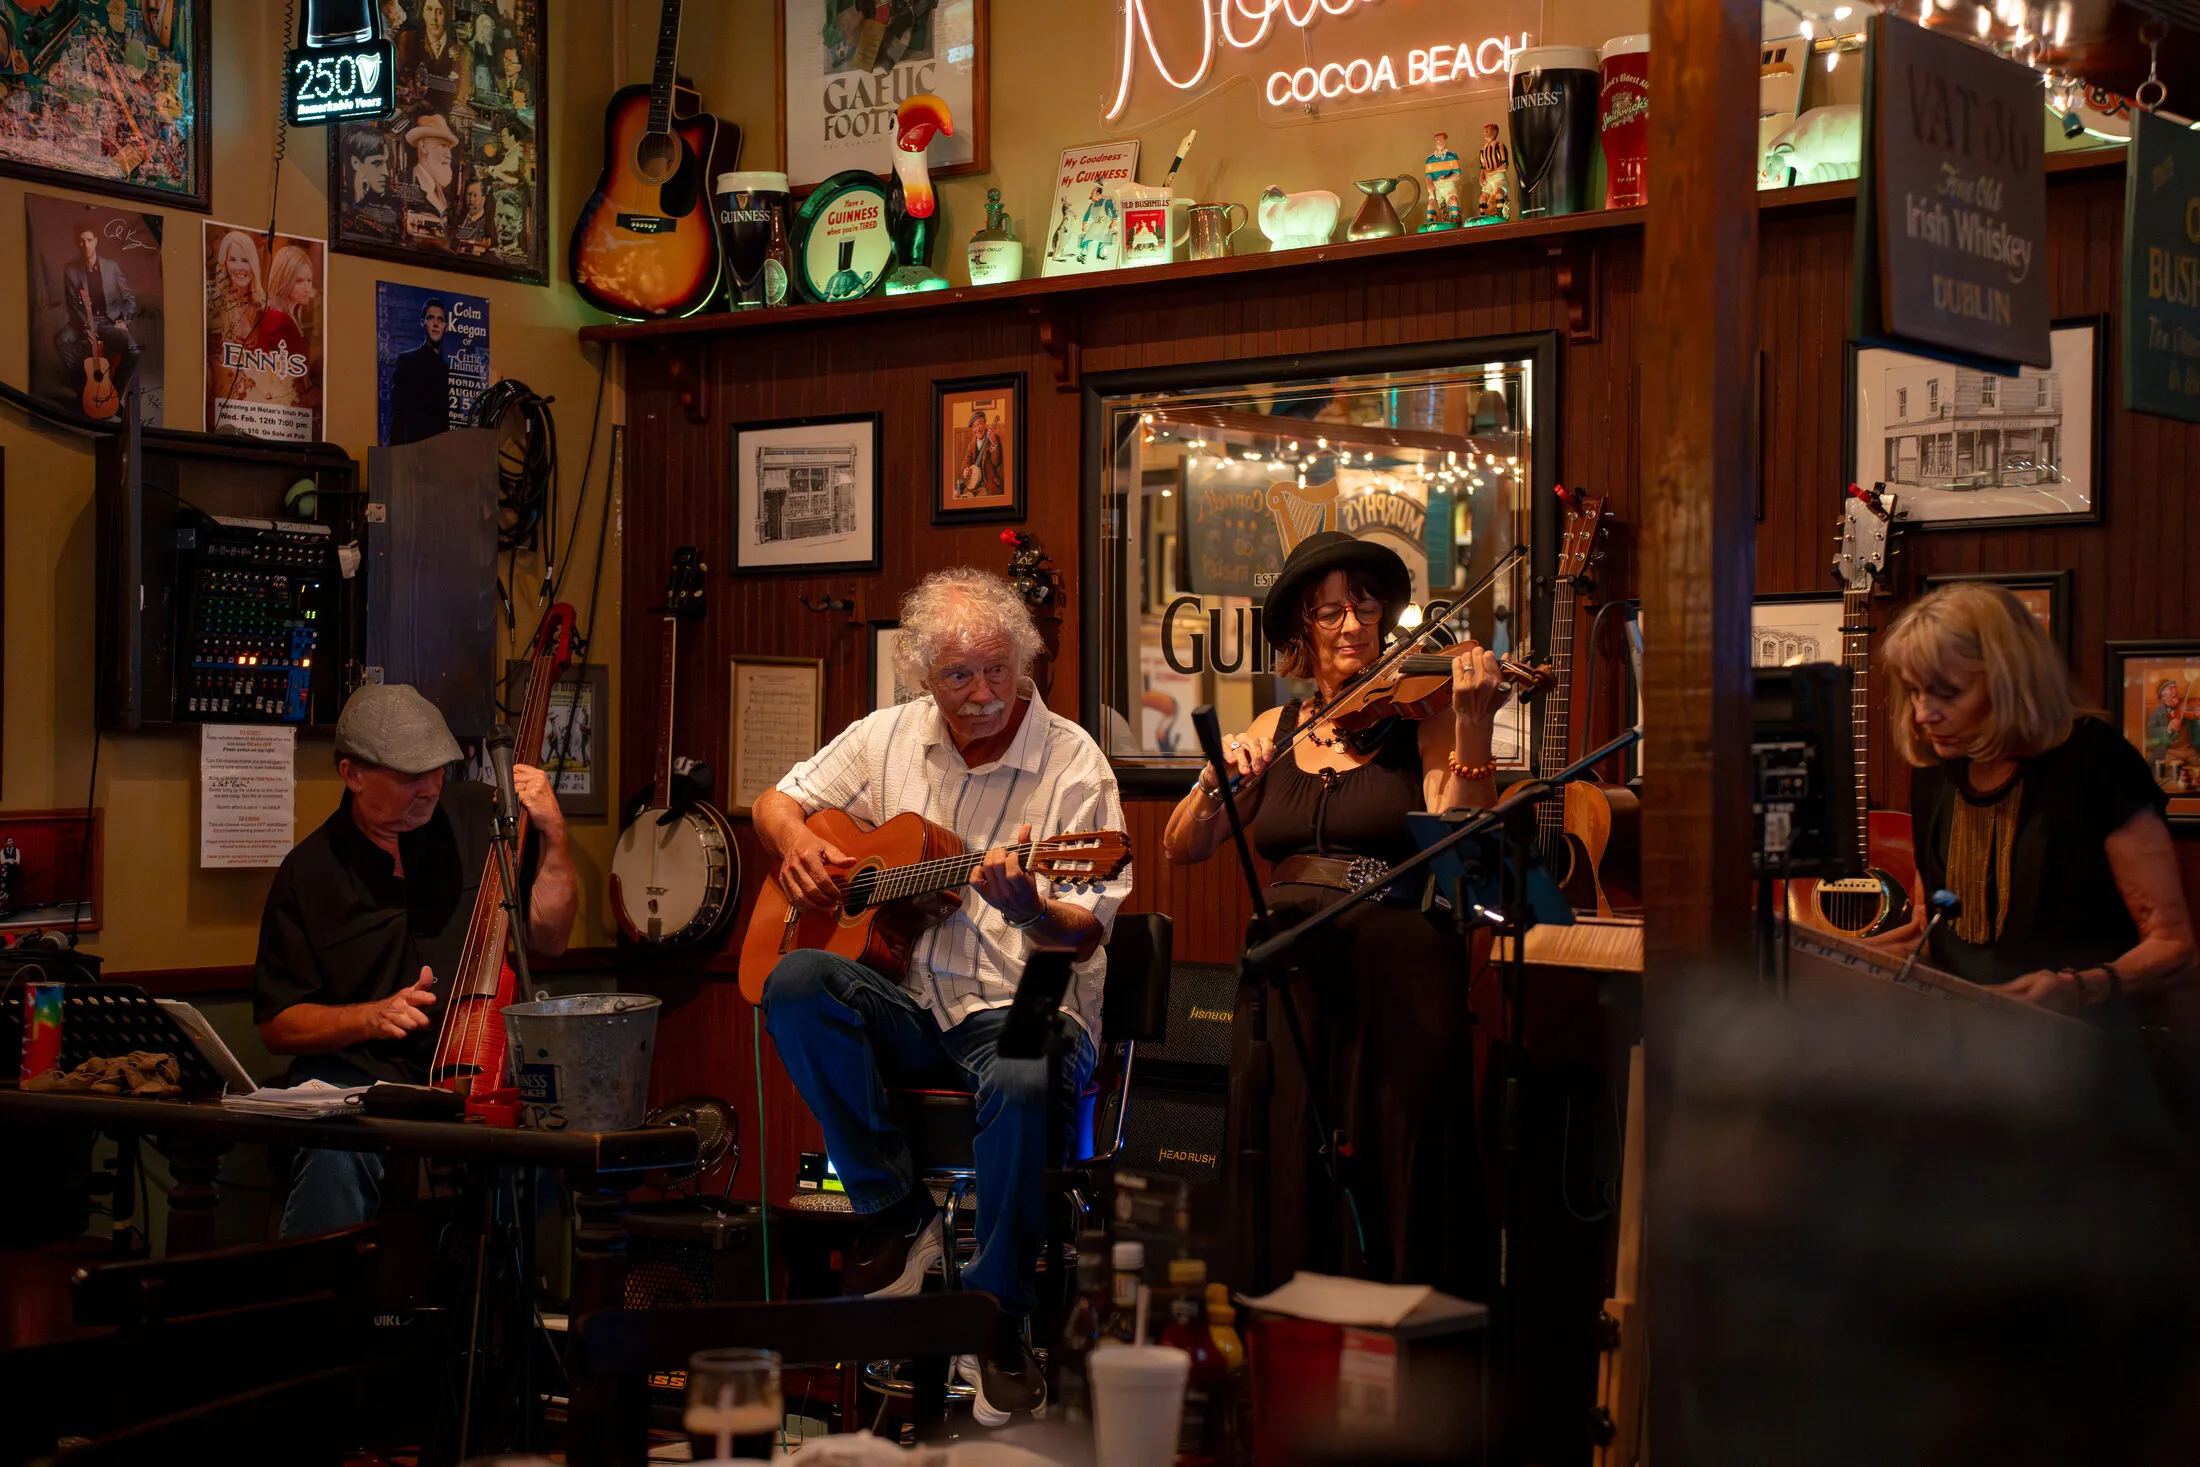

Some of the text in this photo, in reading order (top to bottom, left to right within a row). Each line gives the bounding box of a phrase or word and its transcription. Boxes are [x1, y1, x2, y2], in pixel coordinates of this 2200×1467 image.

[295, 55, 356, 100] 250
[1266, 55, 1399, 106] COCOA
[1408, 31, 1529, 85] BEACH
[297, 97, 382, 115] Remarkable Years
[1508, 91, 1560, 113] GUINNESS
[1907, 63, 1979, 156] VAT
[1601, 95, 1649, 132] Smithwick's
[824, 108, 893, 141] FOOT
[1063, 158, 1078, 169] My
[1061, 169, 1129, 188] My GUINNESS
[844, 199, 859, 208] Have
[720, 209, 771, 224] GUINNESS
[828, 206, 879, 226] GUINNESS
[827, 220, 878, 236] when you're TIRED
[1905, 193, 2033, 284] Irish Whiskey
[1932, 274, 2012, 326] DUBLIN
[453, 301, 482, 320] Colm
[448, 311, 487, 339] Keegan
[447, 377, 488, 390] MONDAY
[448, 387, 481, 398] AUGUS
[257, 406, 281, 415] Nolan's
[282, 409, 297, 417] Irish
[220, 413, 308, 430] Wed. Feb. 12th 7:00 pm
[1254, 572, 1282, 587] EST
[1190, 1007, 1234, 1023] ADRUSH
[1158, 1147, 1217, 1169] HEADRUSH
